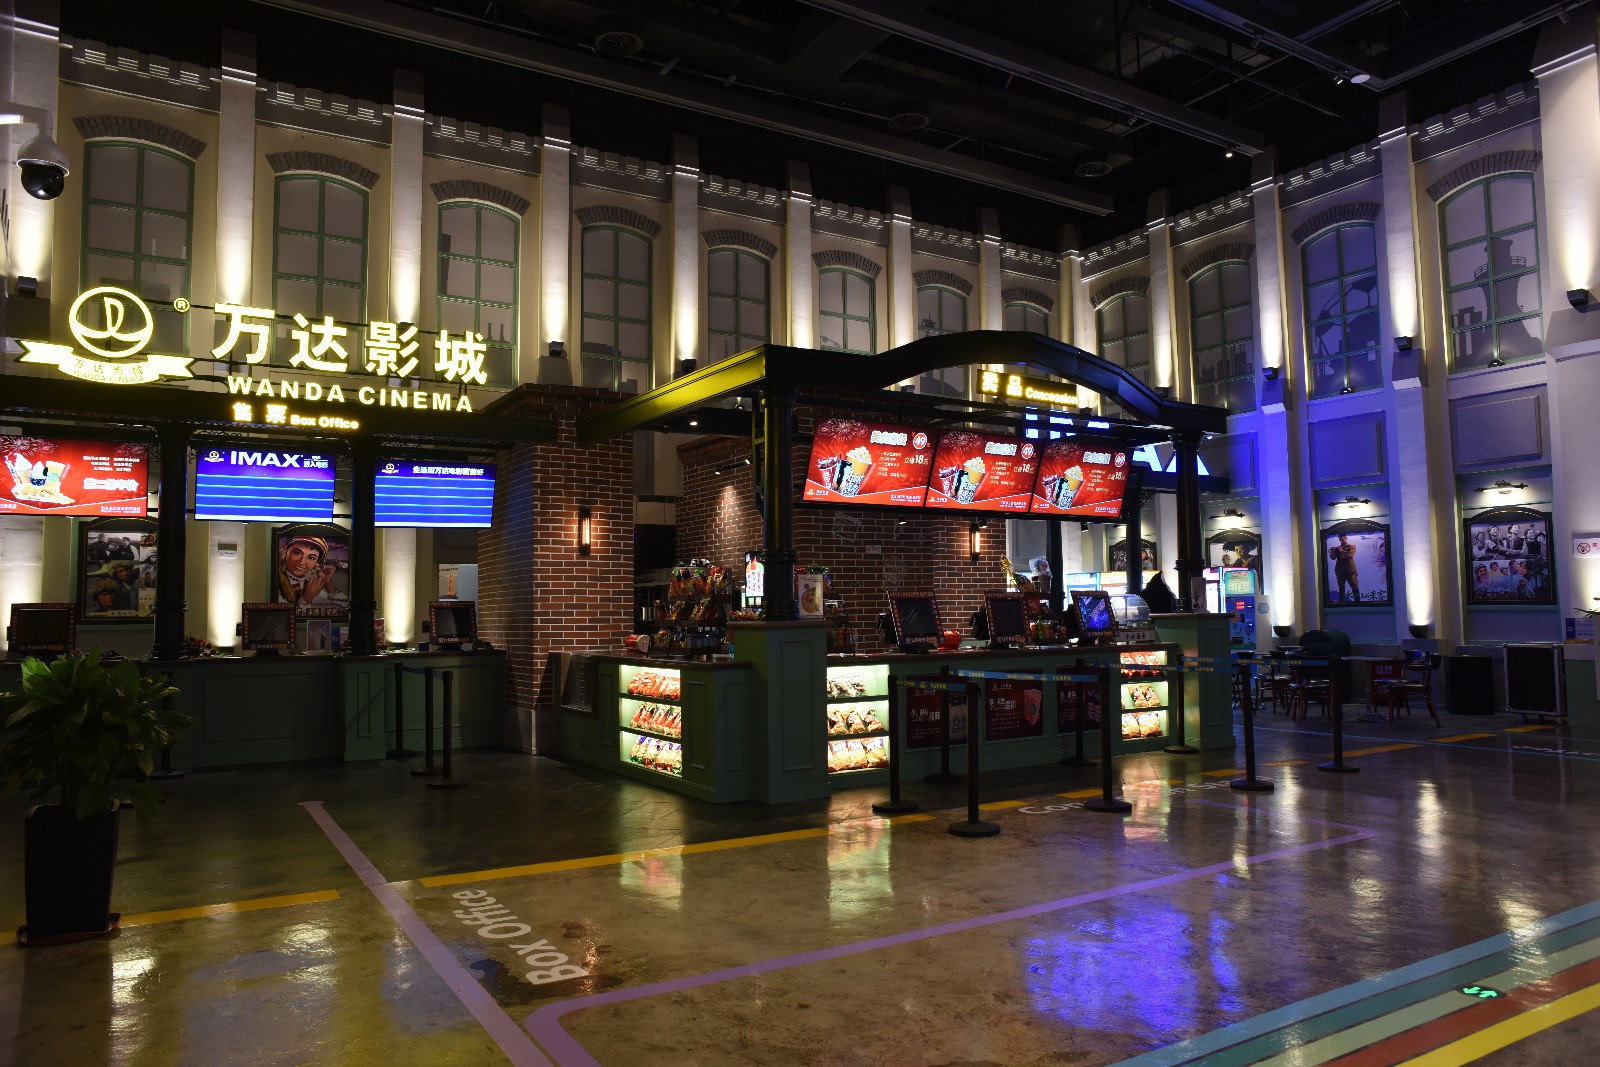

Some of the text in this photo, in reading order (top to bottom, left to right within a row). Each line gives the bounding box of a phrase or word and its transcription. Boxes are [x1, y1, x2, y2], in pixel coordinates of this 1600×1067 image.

[211, 302, 488, 386] 万达影城
[227, 375, 473, 413] WANDA CINEMA
[290, 414, 359, 429] Box Office
[230, 451, 301, 468] IMAX
[452, 888, 590, 986] Box Office
